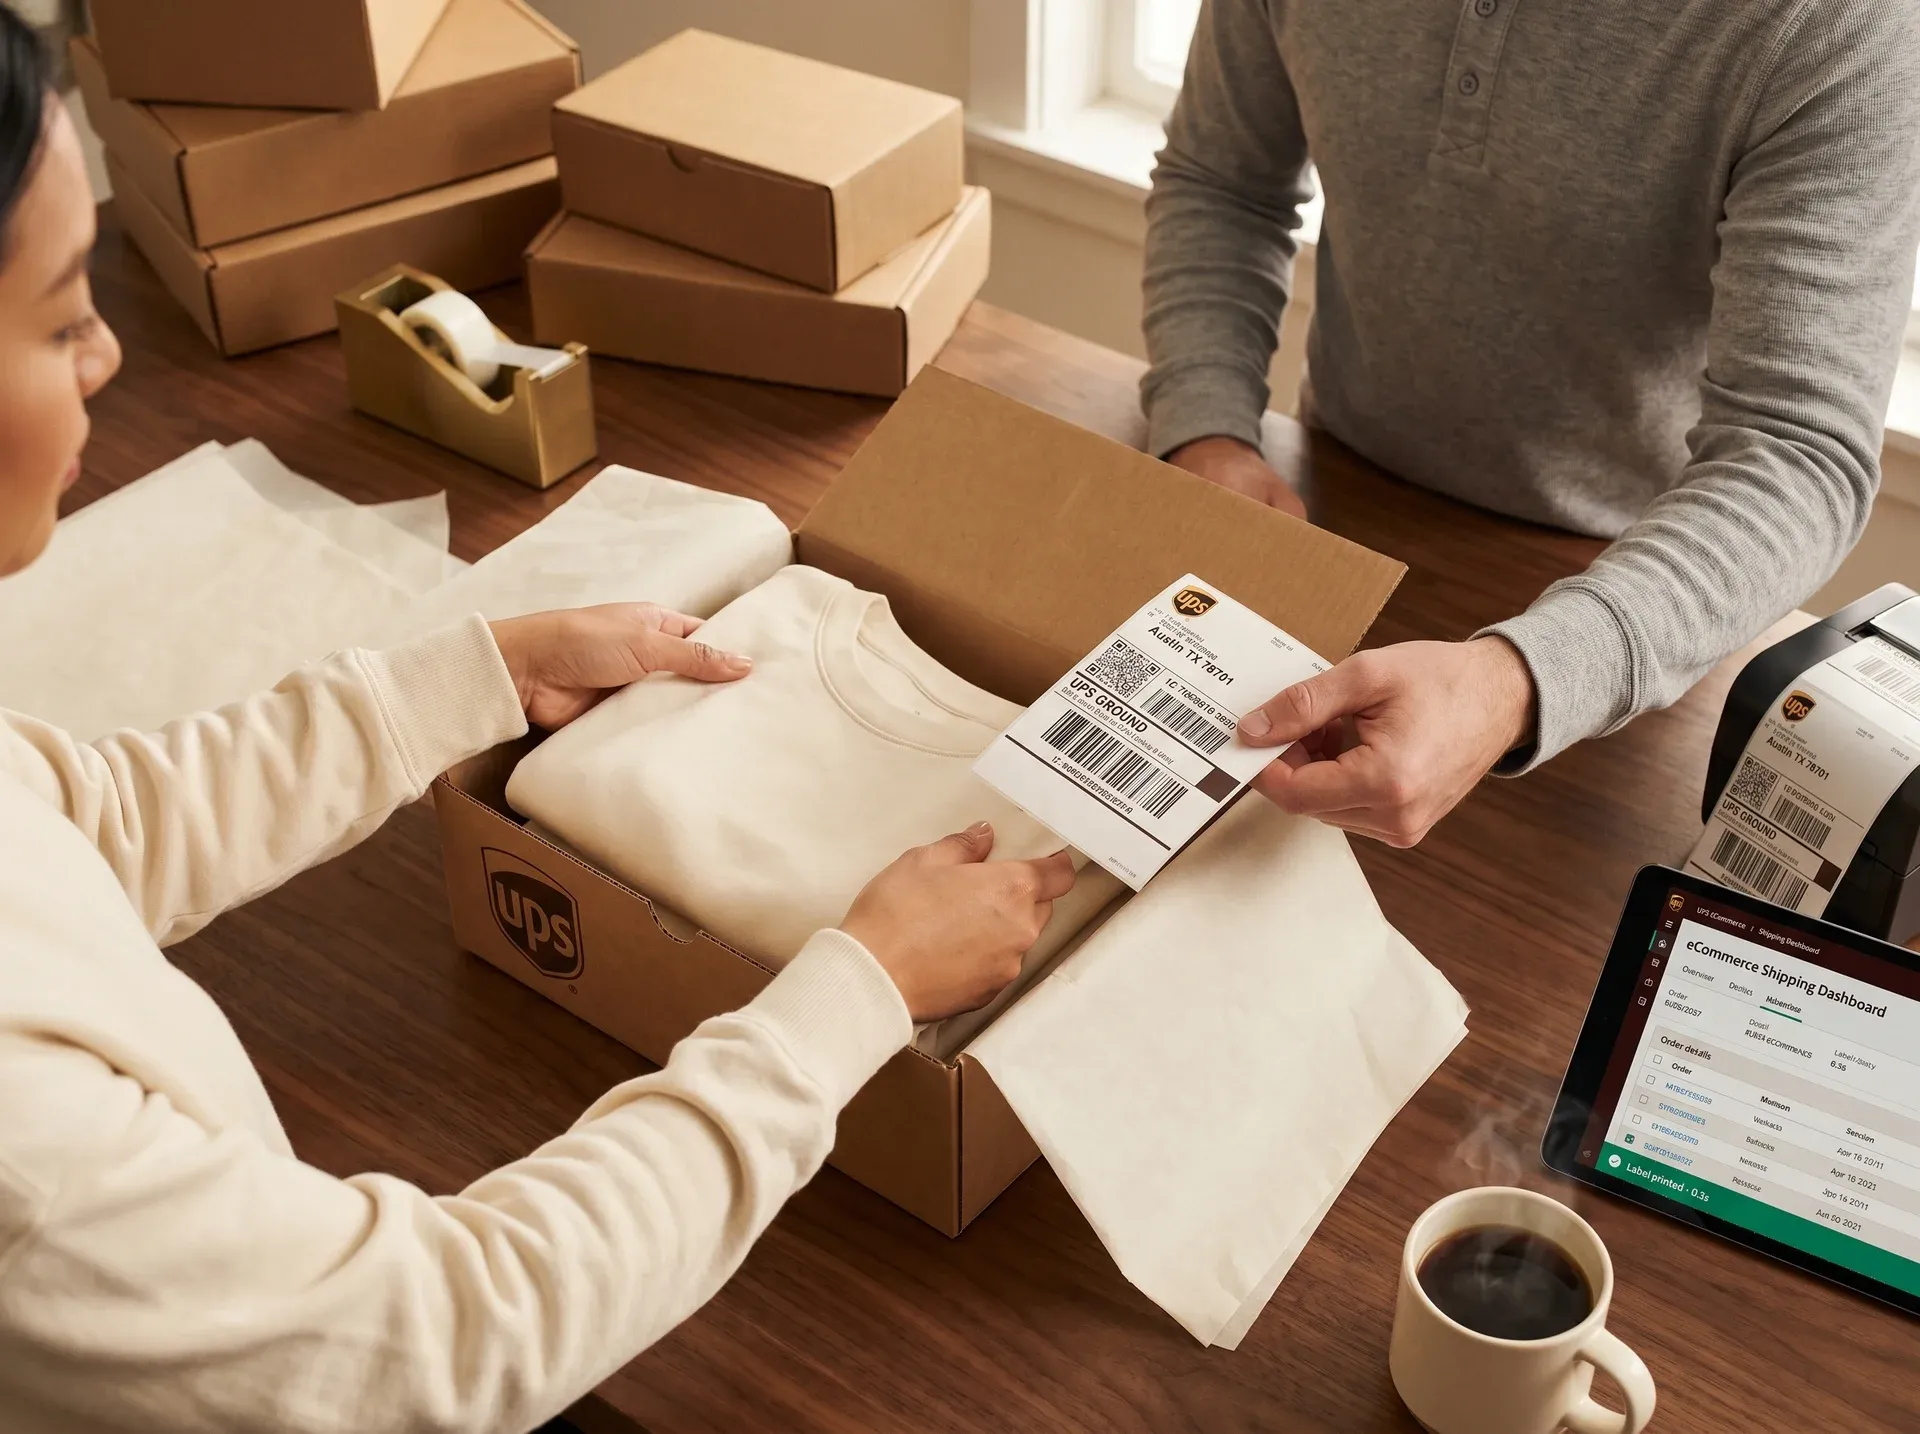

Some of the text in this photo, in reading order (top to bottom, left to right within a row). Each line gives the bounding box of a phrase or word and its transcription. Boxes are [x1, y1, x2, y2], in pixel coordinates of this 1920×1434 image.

[1176, 591, 1209, 614] ups
[1148, 626, 1184, 653] Austin
[1186, 649, 1203, 664] TX
[1201, 660, 1234, 686] 78701
[1070, 678, 1148, 733] UPS GROUND
[1785, 696, 1809, 718] ups
[1794, 753, 1806, 766] TX
[1805, 760, 1830, 781] 78701
[1722, 799, 1777, 840] UPS GROUND
[495, 880, 575, 958] ups
[1686, 941, 1888, 1018] eCommerce Shipping Dashboard
[1668, 988, 1688, 1000] Order
[1660, 1035, 1684, 1050] Order
[1671, 1062, 1692, 1075] Order
[1626, 1163, 1710, 1202] Label printed 0.3s
[1857, 1178, 1877, 1191] 2021
[1842, 1218, 1862, 1232] 2021
